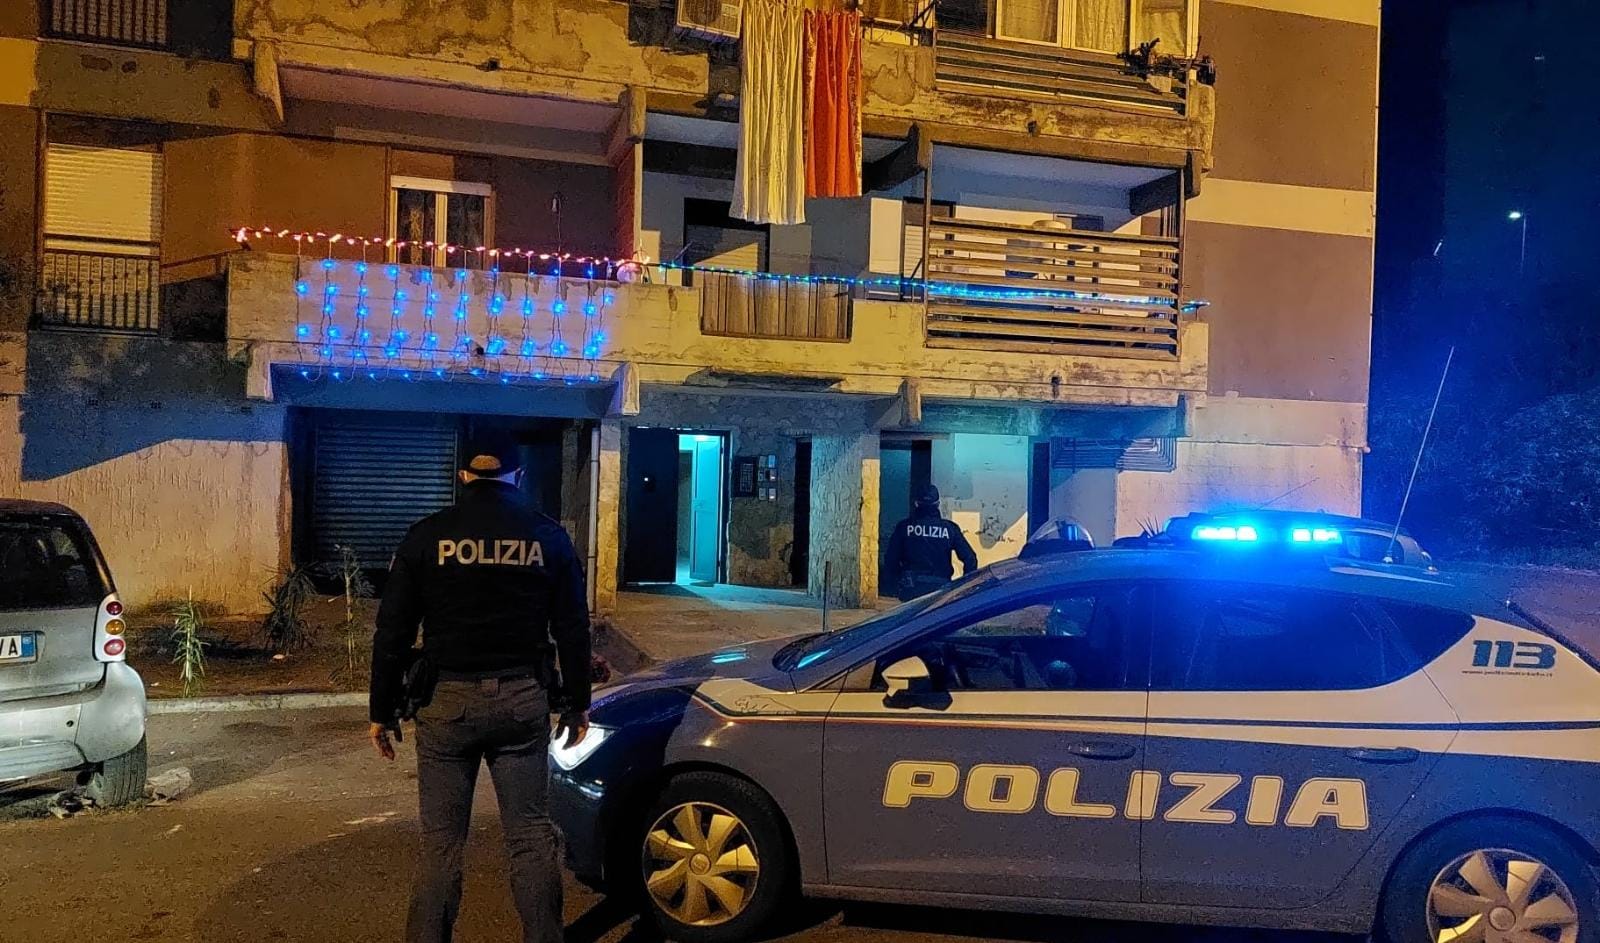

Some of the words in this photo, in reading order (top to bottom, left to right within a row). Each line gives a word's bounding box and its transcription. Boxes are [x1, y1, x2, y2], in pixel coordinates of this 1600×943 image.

[907, 525, 949, 539] POLIZIA
[438, 539, 544, 566] POLIZIA
[1472, 640, 1557, 669] 113
[882, 760, 1369, 830] POLIZIA
